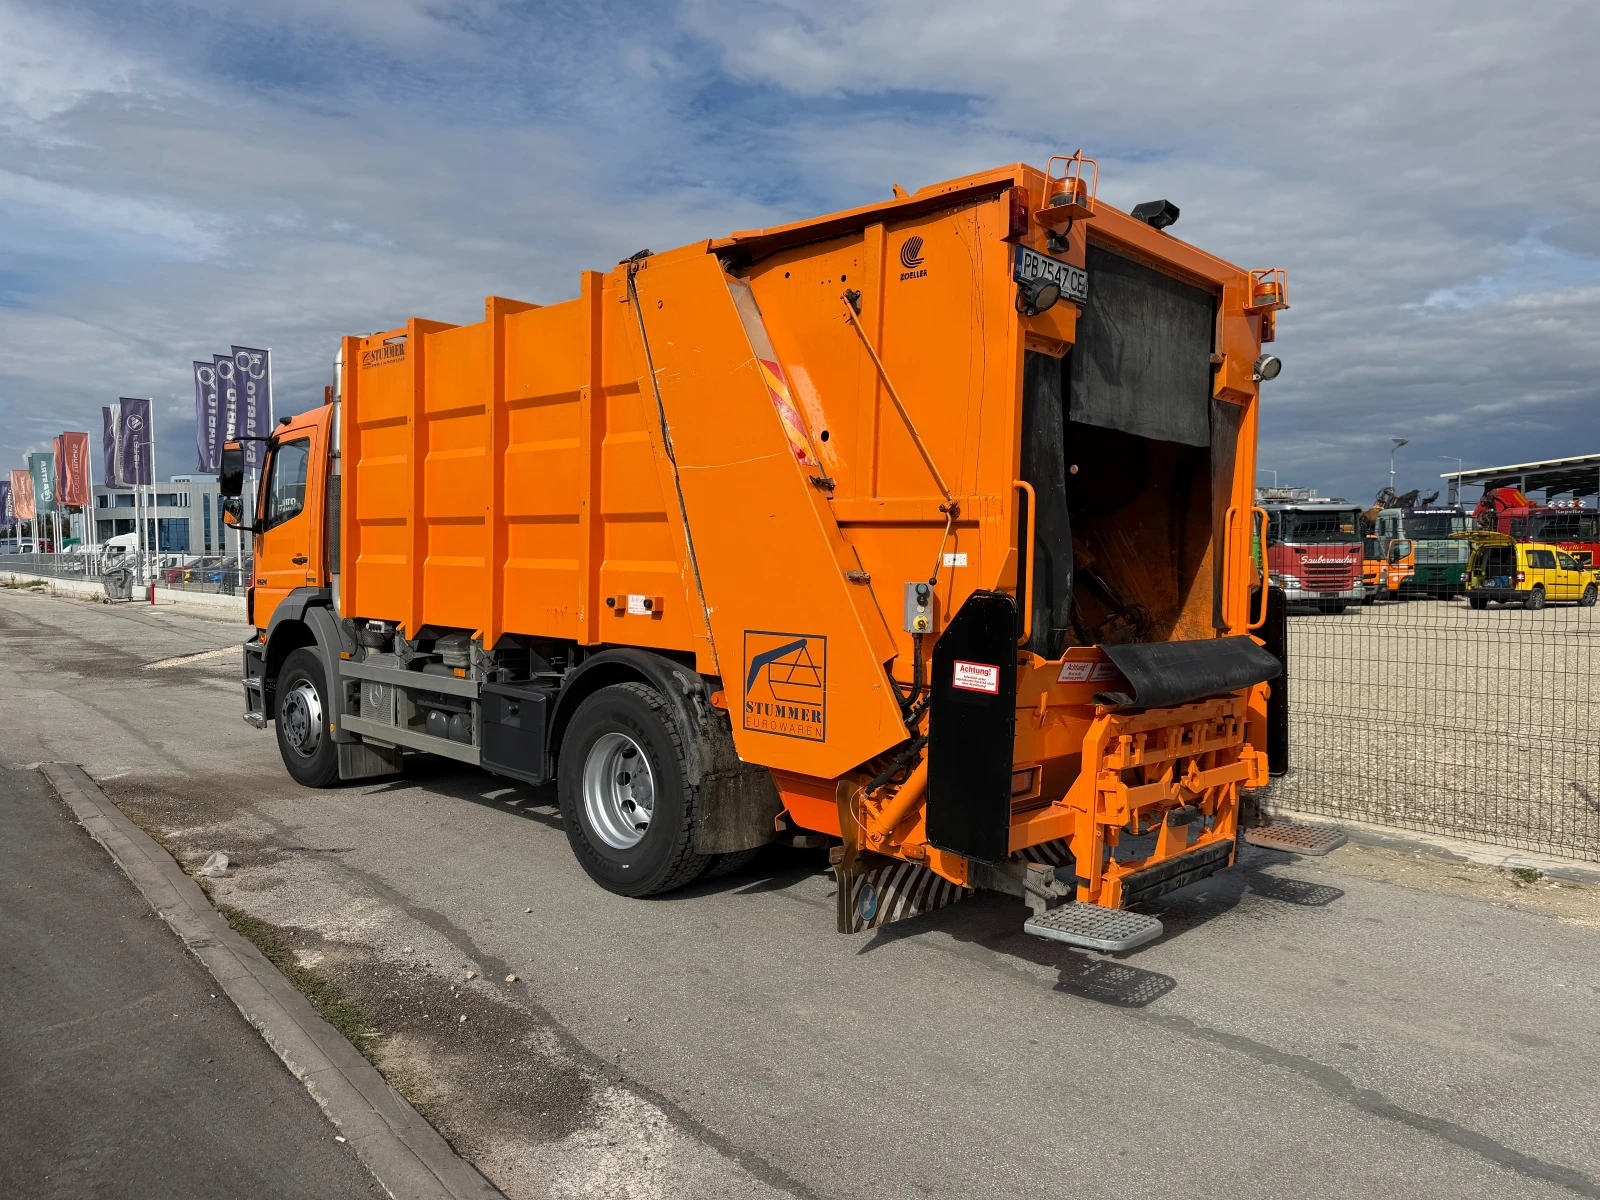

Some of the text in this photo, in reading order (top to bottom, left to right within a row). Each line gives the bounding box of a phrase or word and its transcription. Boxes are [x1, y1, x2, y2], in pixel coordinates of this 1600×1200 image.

[900, 269, 928, 282] ZOELLER
[1023, 252, 1085, 295] PB 7547 CE
[371, 343, 405, 362] STUMMER
[1299, 555, 1358, 565] Saubermacher
[959, 664, 992, 678] Achtung!
[745, 700, 822, 724] STUMMER
[746, 716, 822, 738] EUROWAREN
